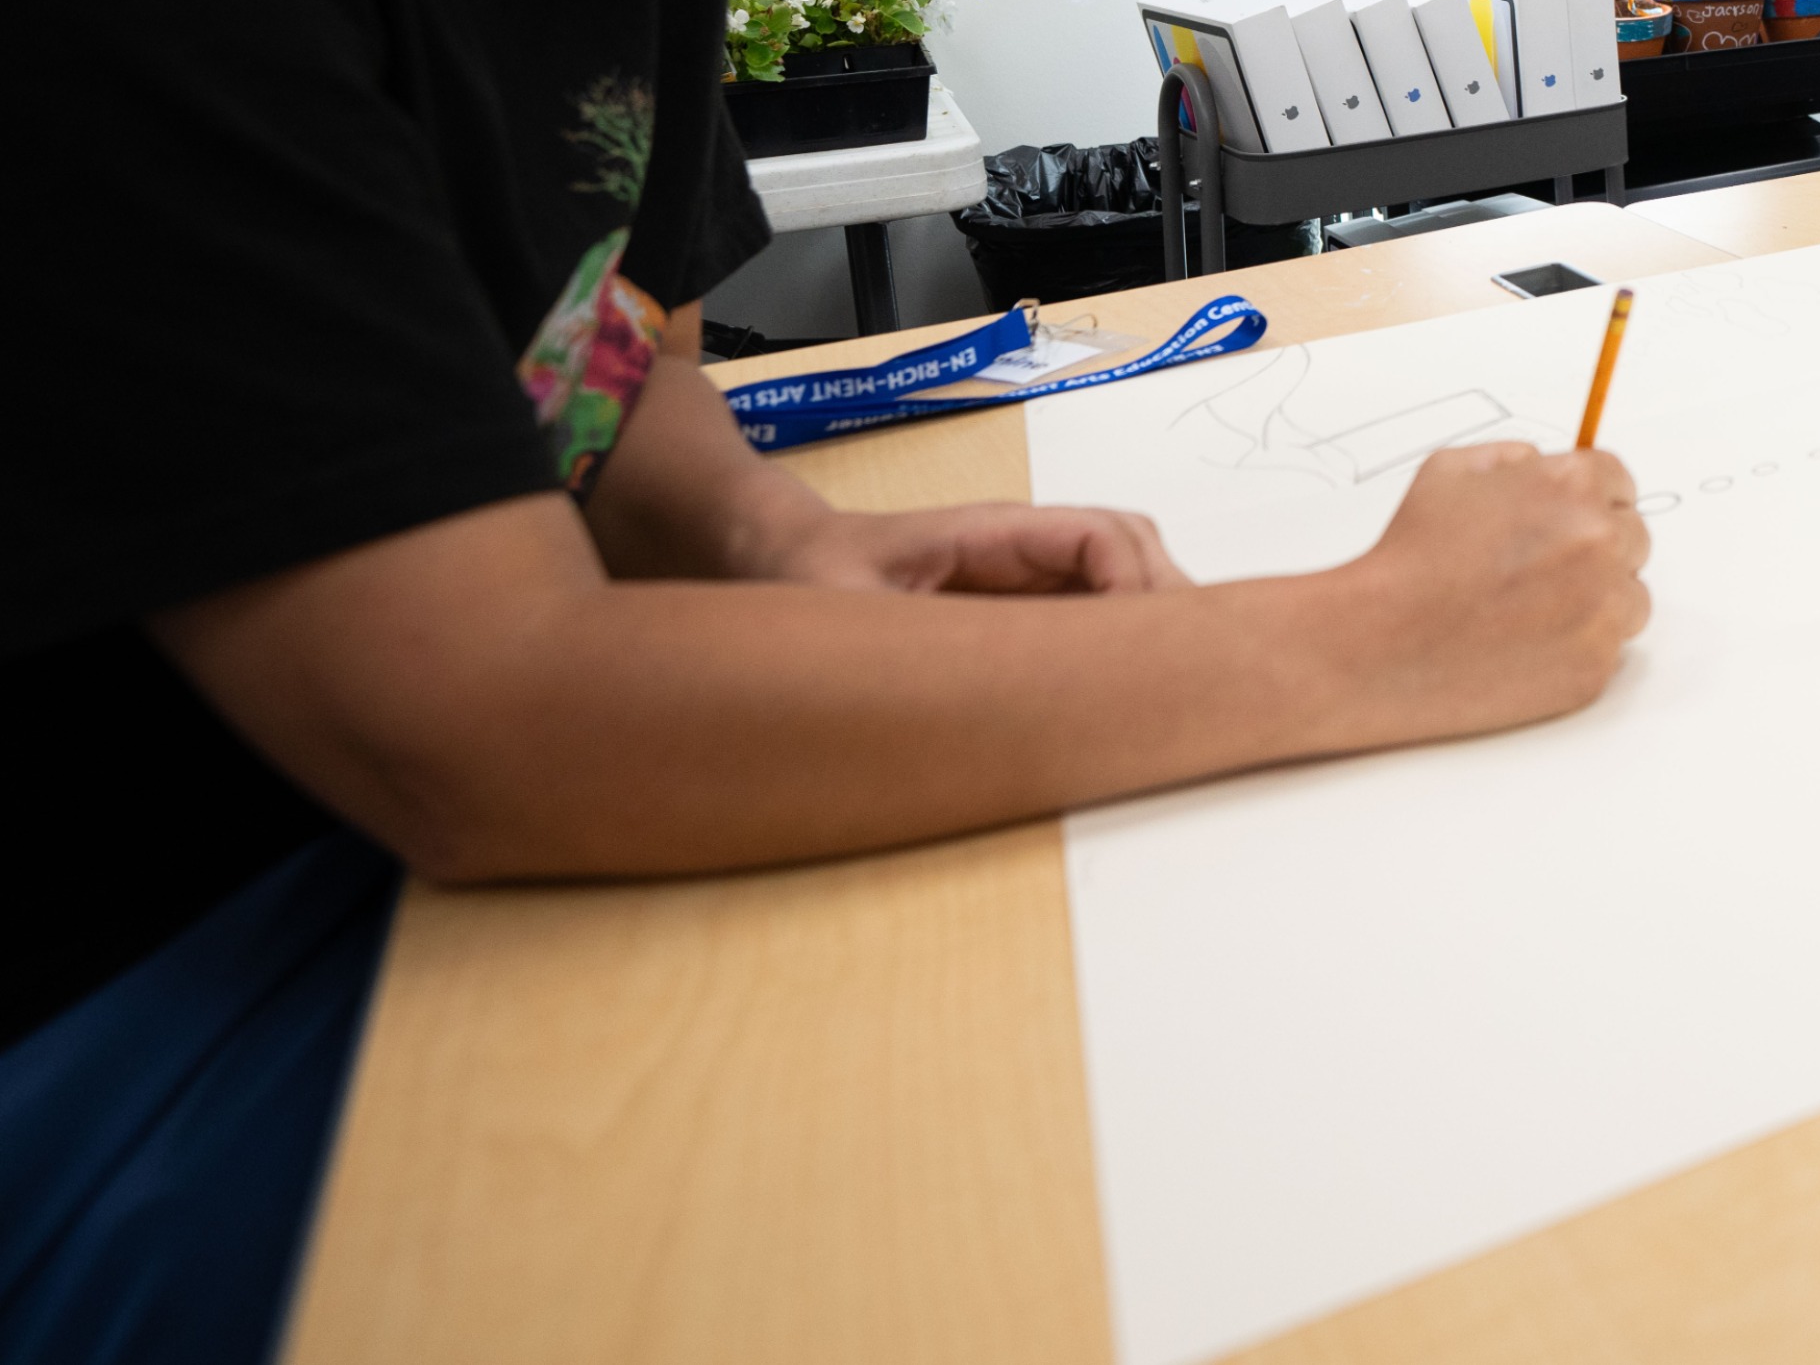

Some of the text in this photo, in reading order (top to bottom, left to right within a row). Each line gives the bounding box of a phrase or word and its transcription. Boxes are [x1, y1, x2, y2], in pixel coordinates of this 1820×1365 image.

[809, 346, 978, 404] EN-RICH-MENT
[1063, 373, 1110, 388] Arts
[1112, 318, 1209, 378] Education
[754, 386, 808, 408] Arts
